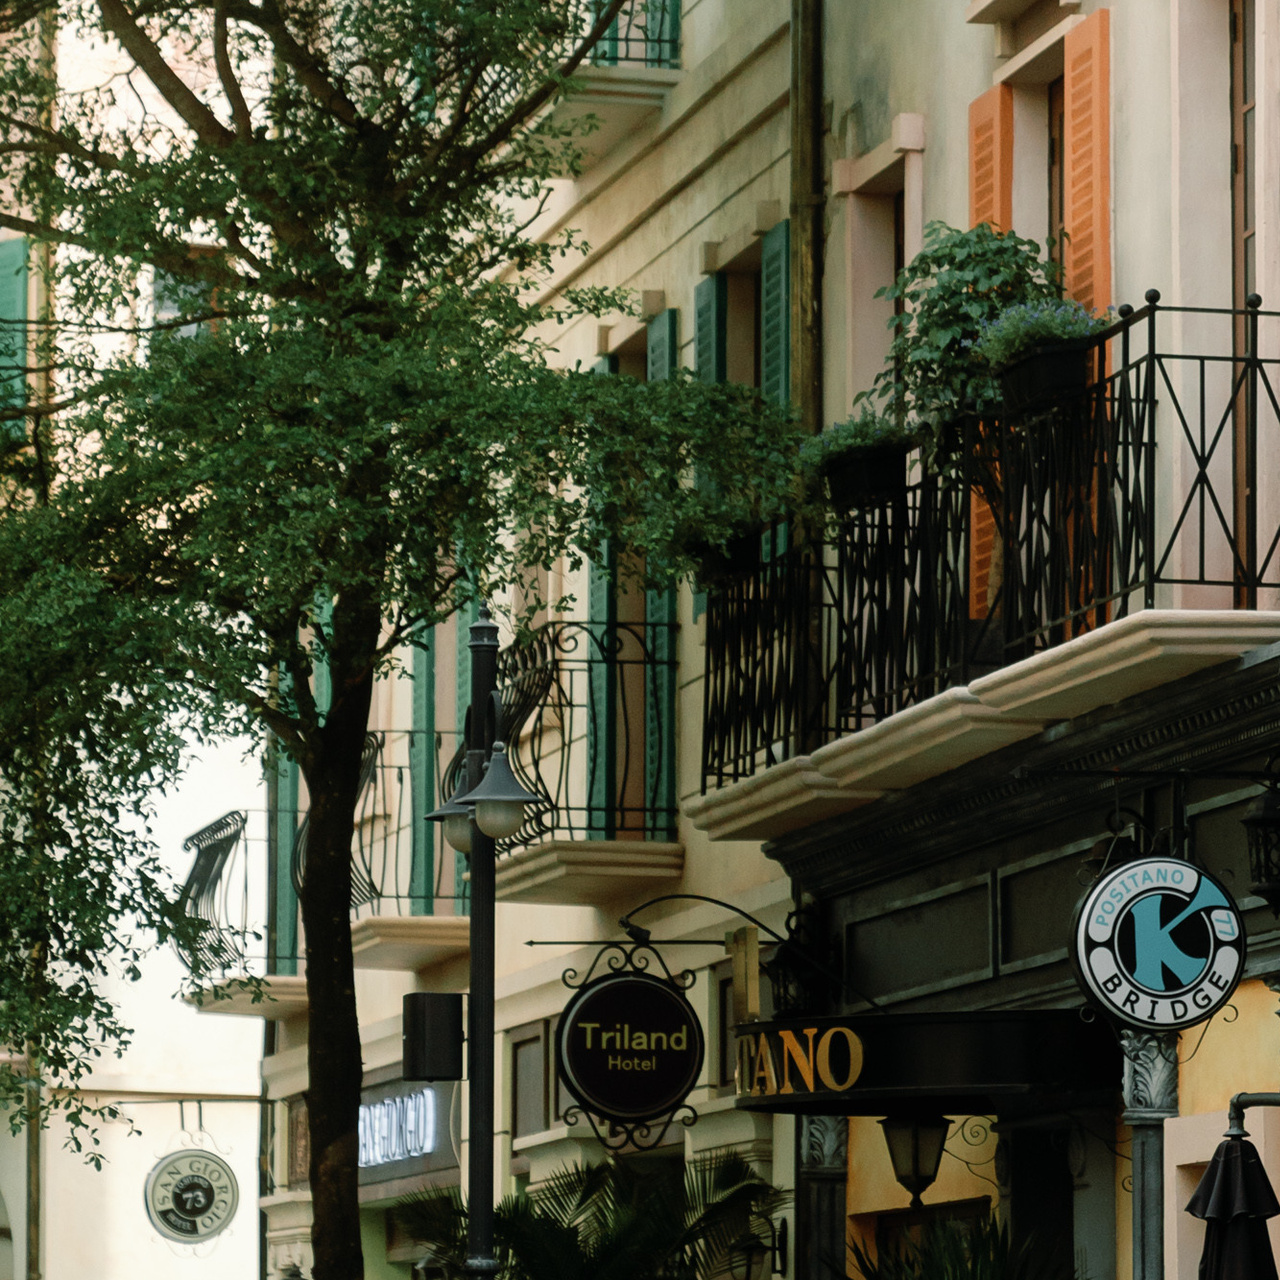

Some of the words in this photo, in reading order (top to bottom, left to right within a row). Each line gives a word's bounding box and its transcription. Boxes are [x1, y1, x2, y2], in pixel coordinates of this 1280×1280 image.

[1095, 868, 1184, 926] POSITANO
[1214, 912, 1235, 937] 77
[1102, 970, 1229, 1021] BRIDGE
[578, 1022, 688, 1051] Triland
[608, 1055, 656, 1071] Hotel
[158, 1164, 182, 1205] SAN
[189, 1160, 228, 1228] GIORGIO
[182, 1190, 207, 1210] 73
